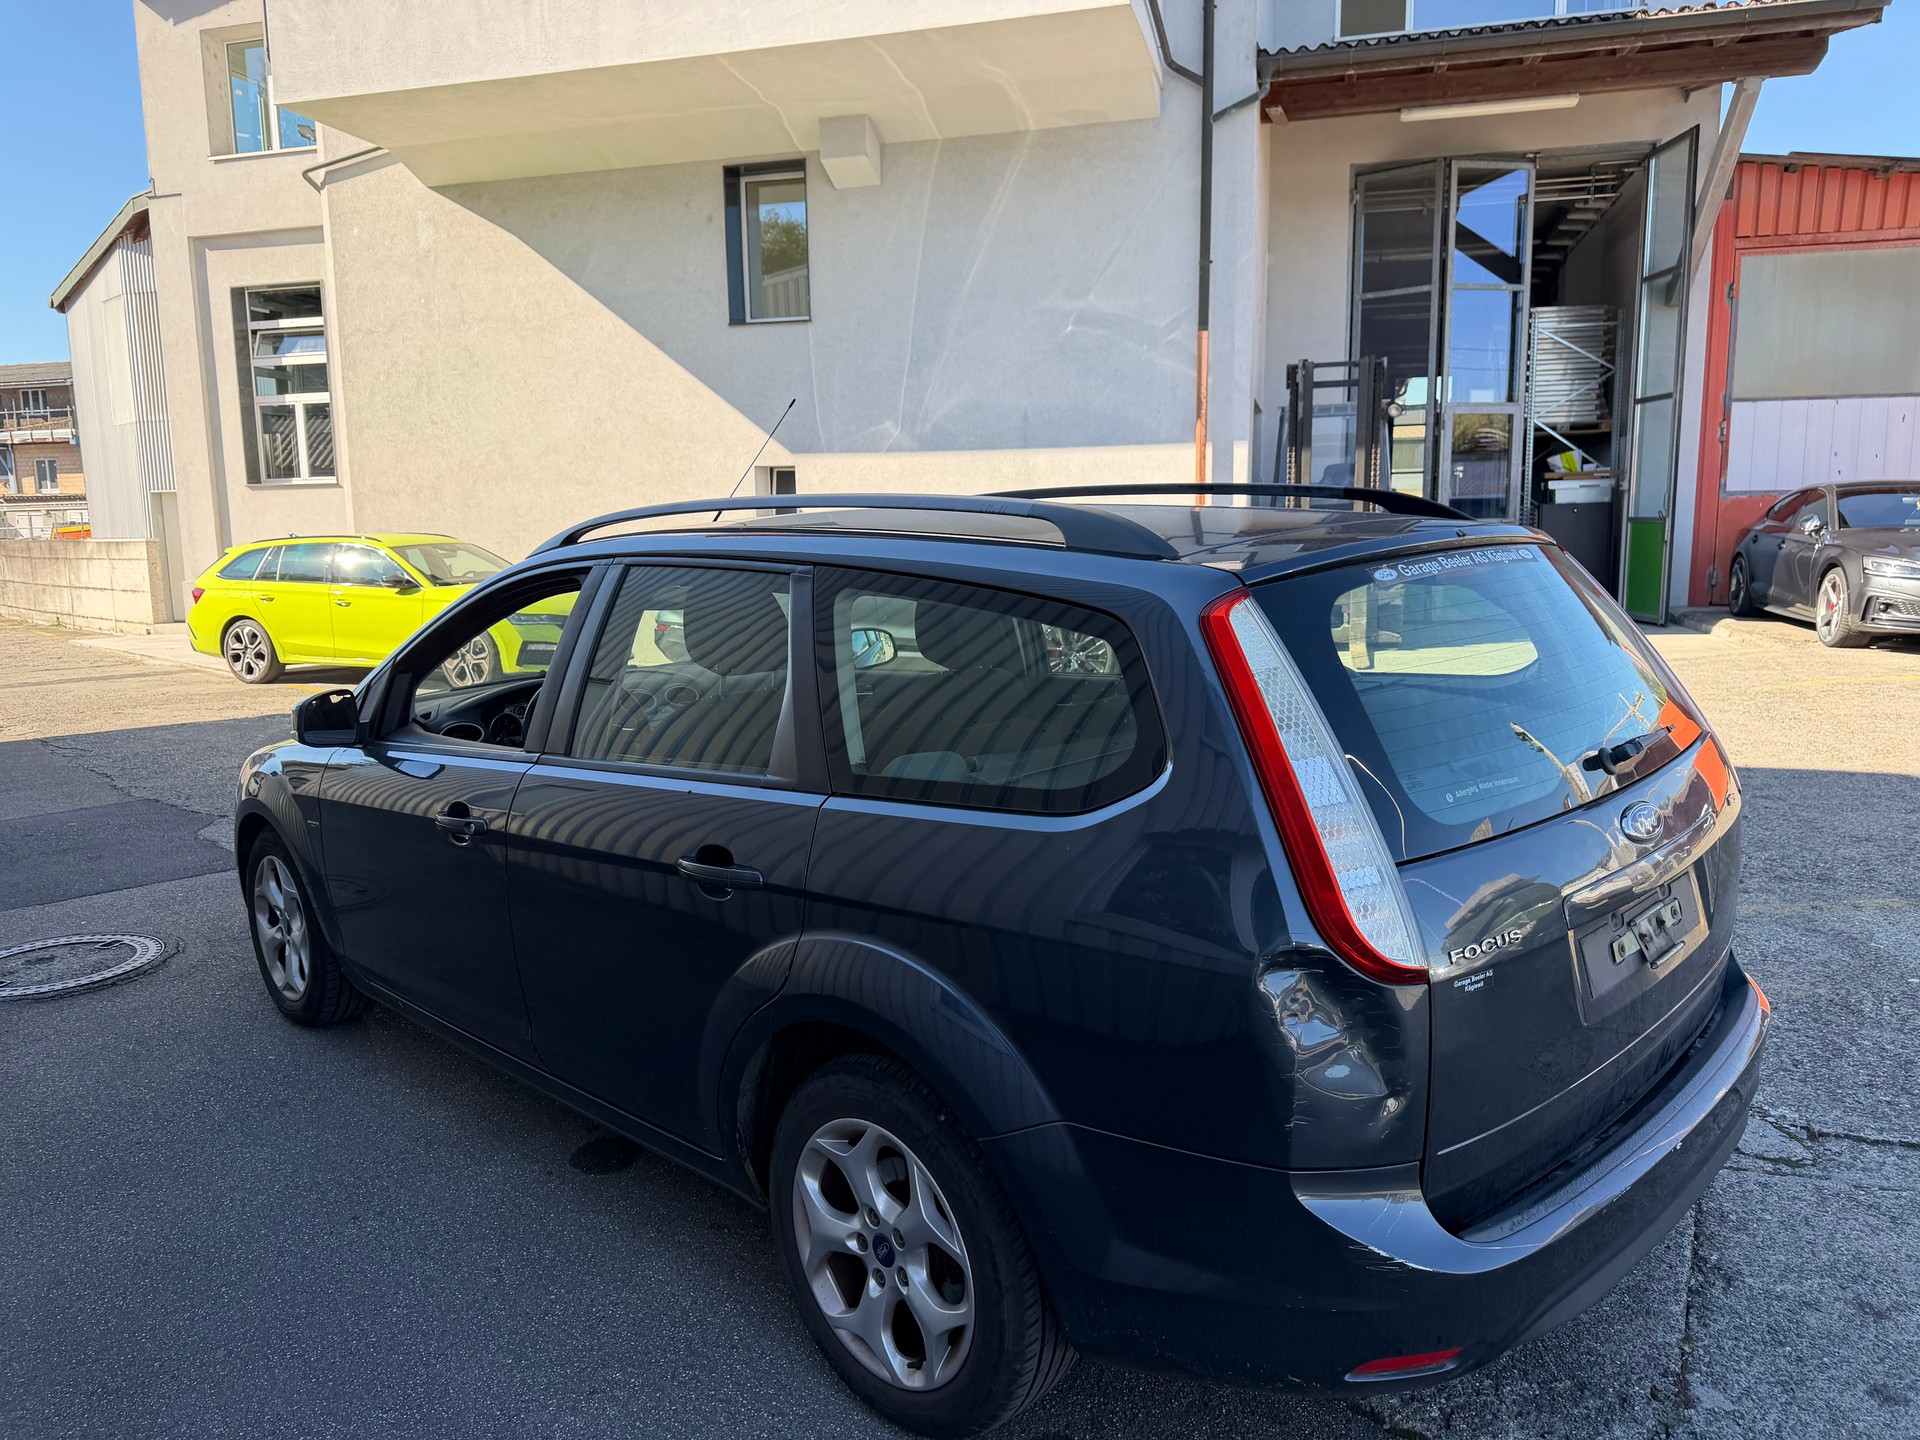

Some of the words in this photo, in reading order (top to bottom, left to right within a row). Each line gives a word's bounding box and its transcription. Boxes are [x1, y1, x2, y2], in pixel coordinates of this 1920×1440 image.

[1397, 561, 1441, 576] Garage
[1437, 554, 1473, 568] Beeler
[1471, 552, 1489, 563] AG
[1484, 549, 1522, 563] Kägiswil
[1449, 929, 1522, 965] FOCUS
[1453, 978, 1471, 988] Garage
[1485, 969, 1494, 978] AG
